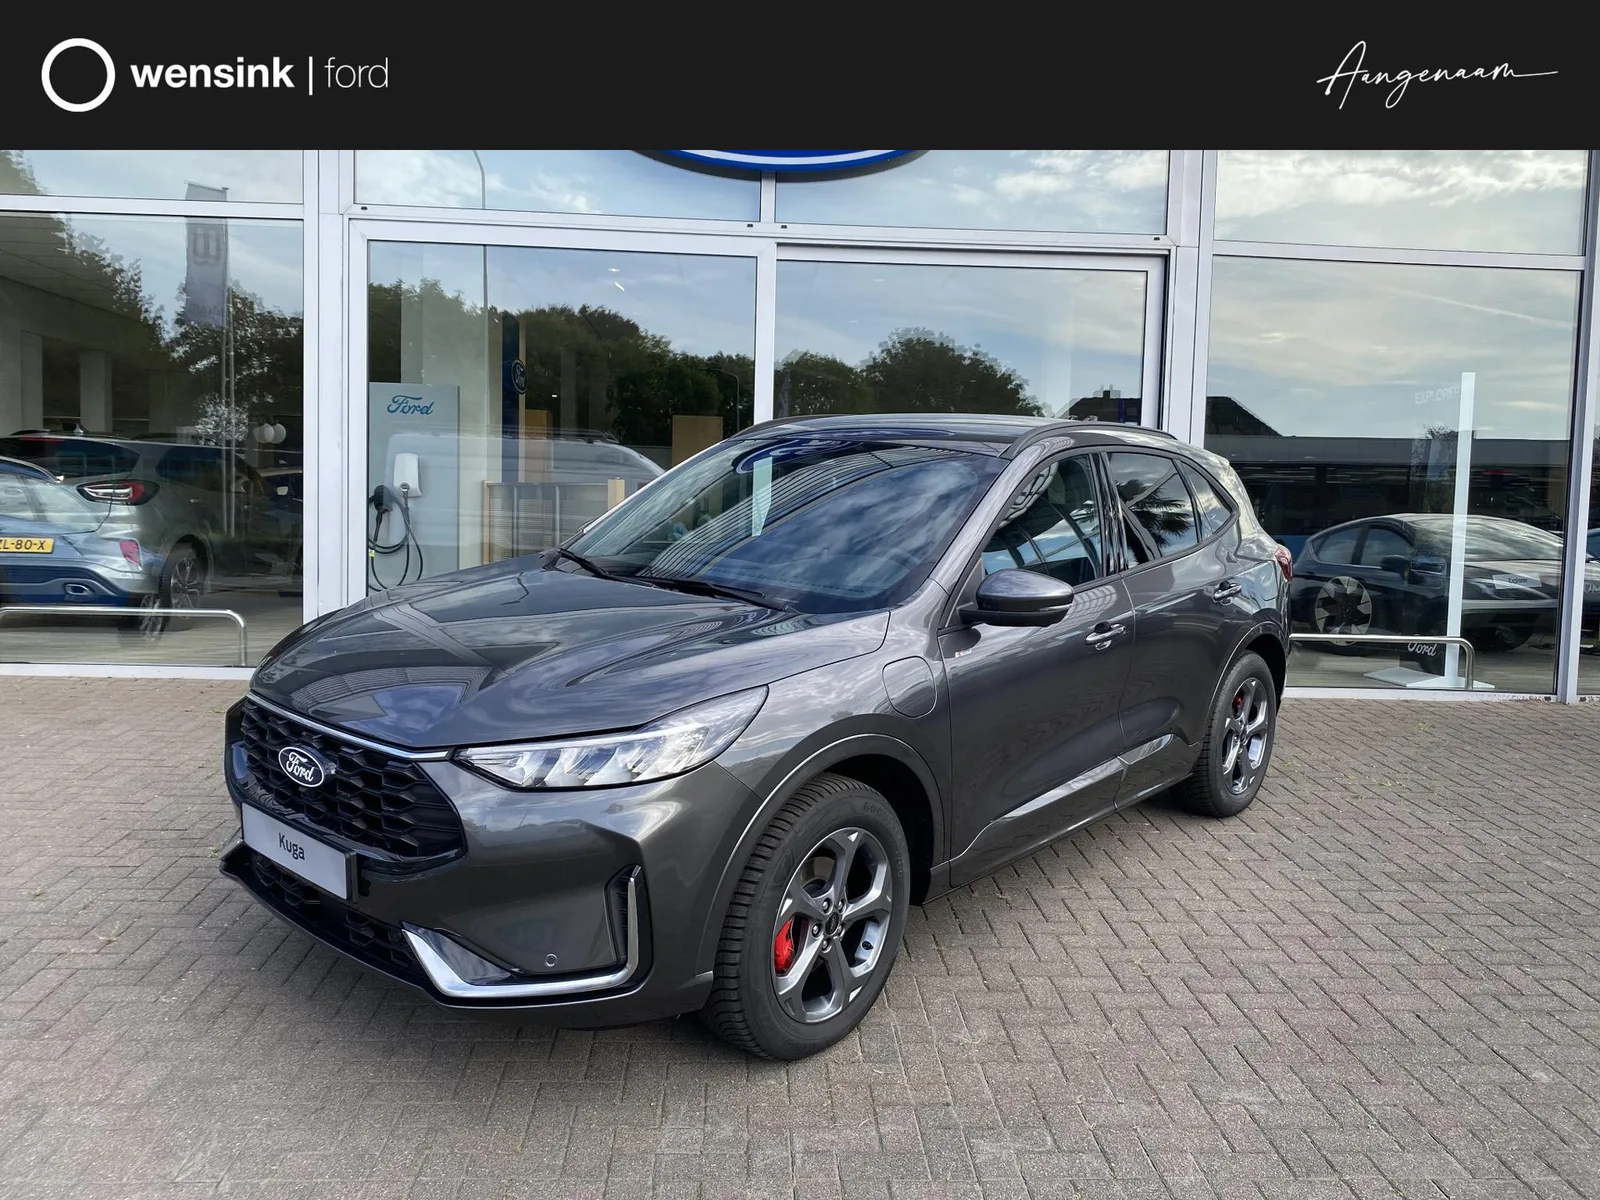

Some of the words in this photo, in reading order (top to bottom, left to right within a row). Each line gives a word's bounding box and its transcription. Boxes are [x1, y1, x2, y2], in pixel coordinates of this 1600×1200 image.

[387, 394, 434, 416] Ford
[286, 751, 316, 782] Ford
[278, 832, 306, 861] Kuga
